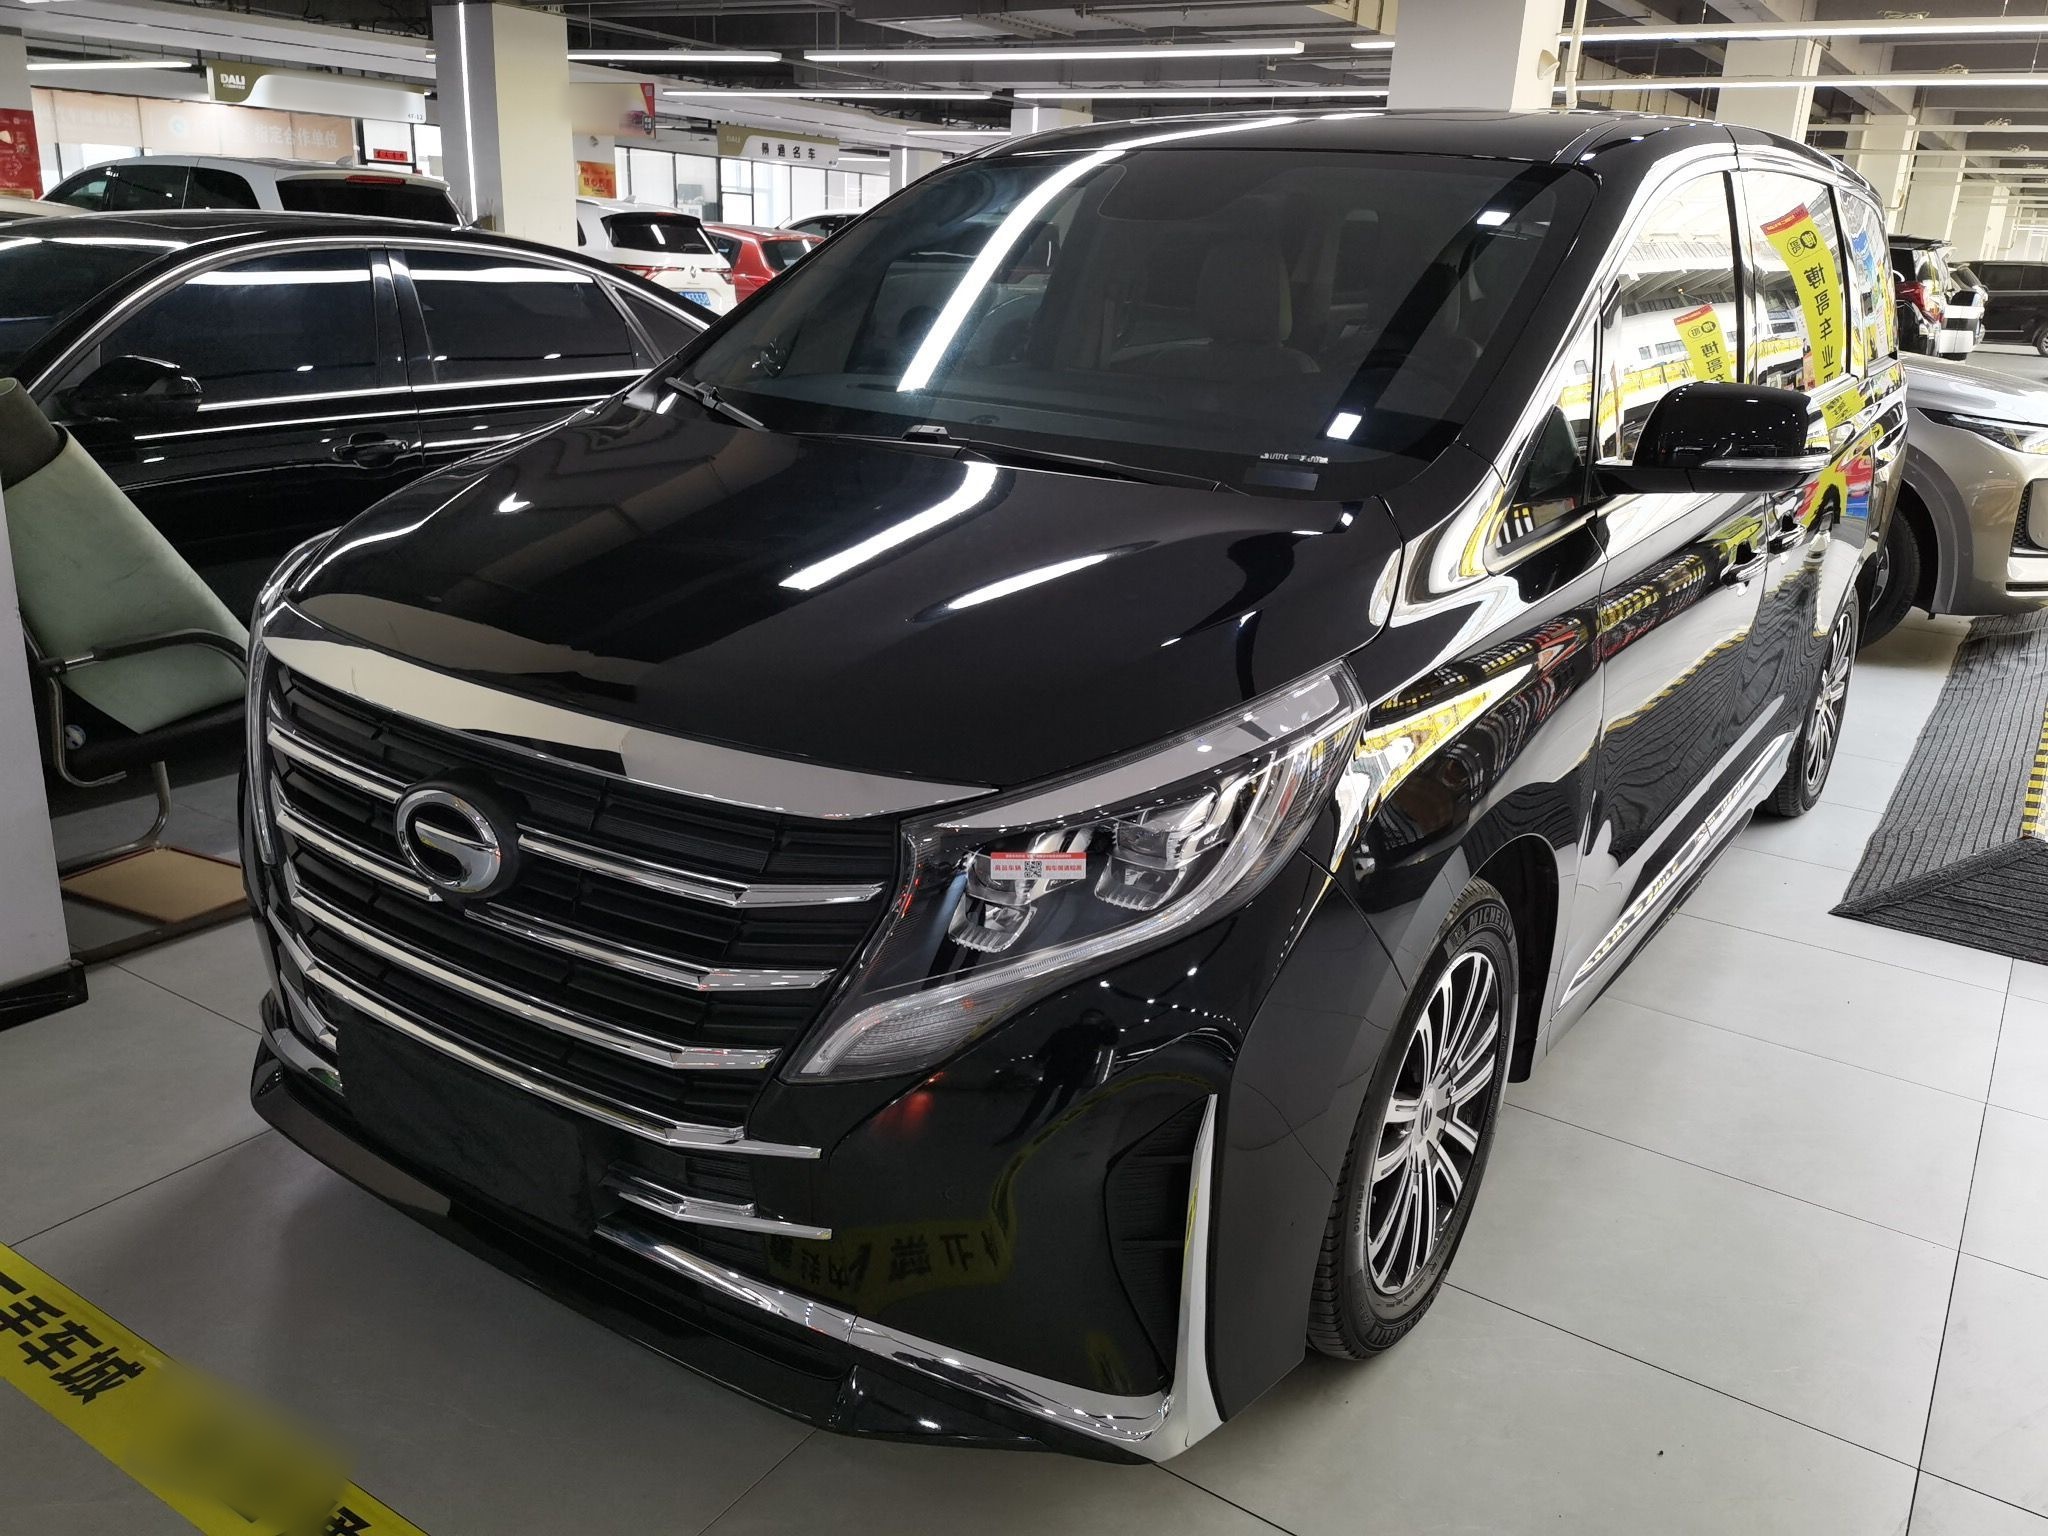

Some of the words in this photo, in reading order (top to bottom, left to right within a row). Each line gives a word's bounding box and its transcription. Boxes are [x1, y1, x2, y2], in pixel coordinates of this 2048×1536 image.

[220, 73, 246, 85] DALI
[1468, 906, 1514, 939] MICHELIN
[0, 1271, 147, 1405] 手车城
